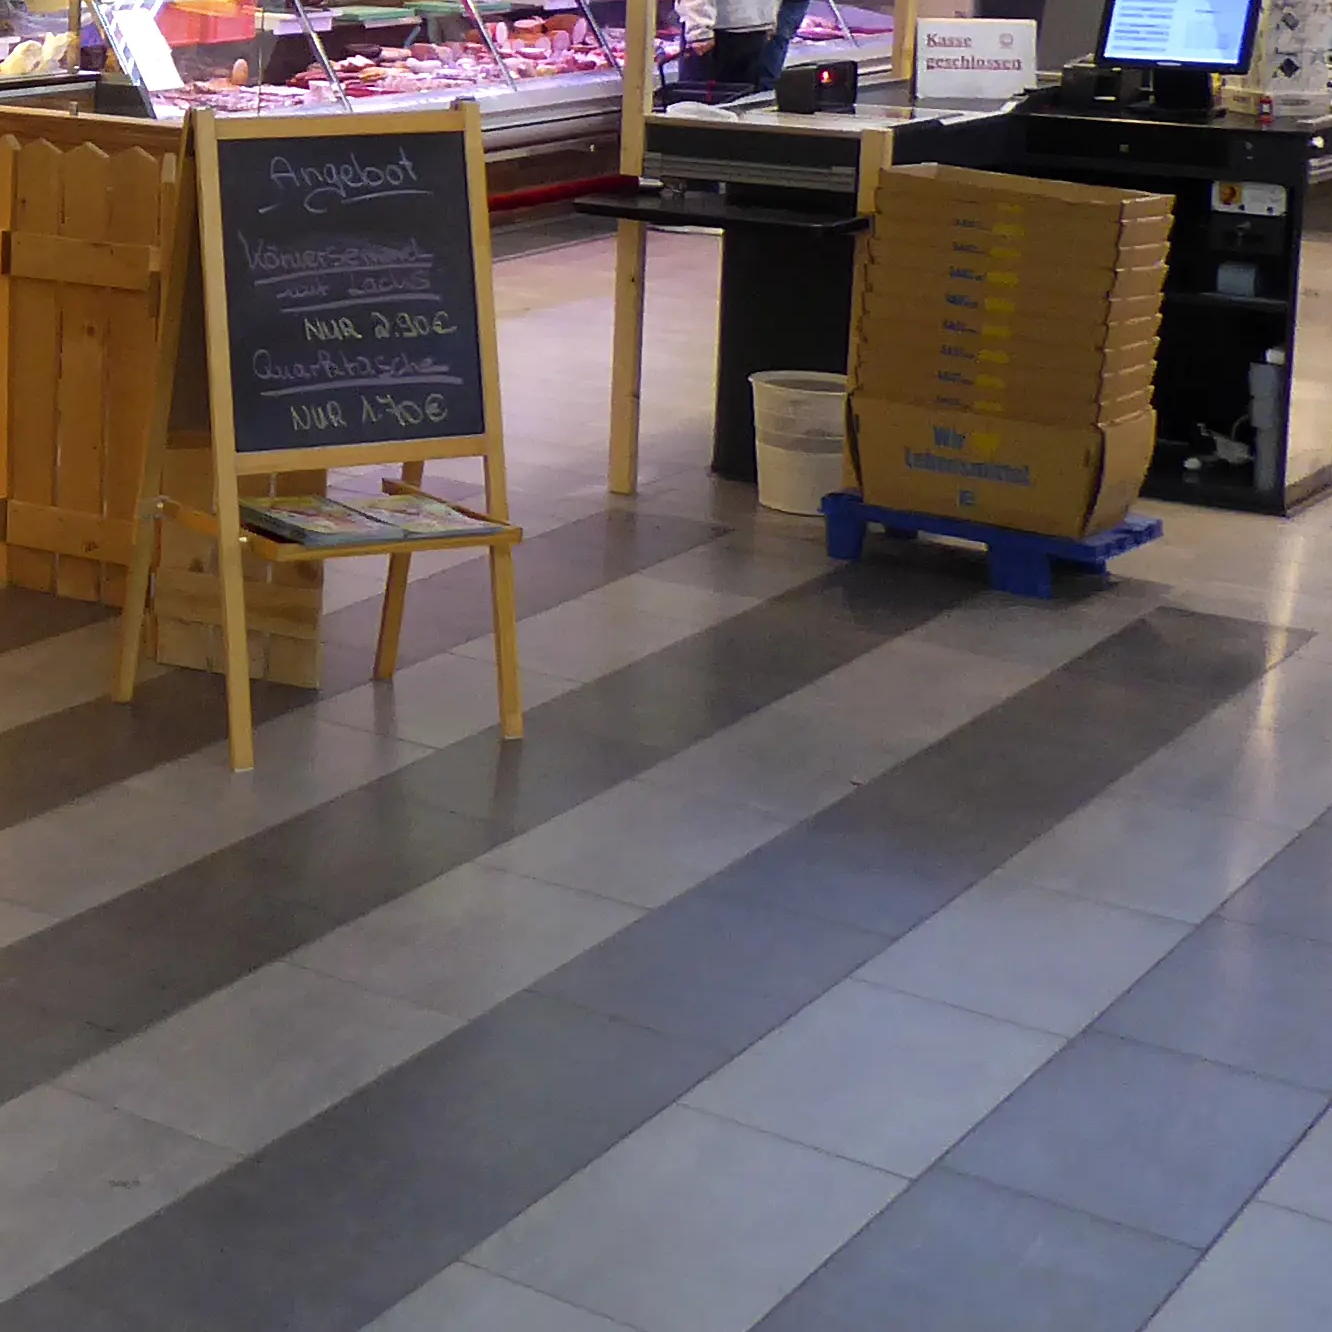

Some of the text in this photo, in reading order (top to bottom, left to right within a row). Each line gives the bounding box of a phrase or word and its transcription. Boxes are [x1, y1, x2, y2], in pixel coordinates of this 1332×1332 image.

[925, 32, 973, 48] Kasse
[925, 54, 1023, 71] geschlossen
[268, 146, 420, 214] Angebot
[347, 270, 432, 298] Lachs
[303, 318, 364, 342] NUR
[290, 400, 349, 432] NUR
